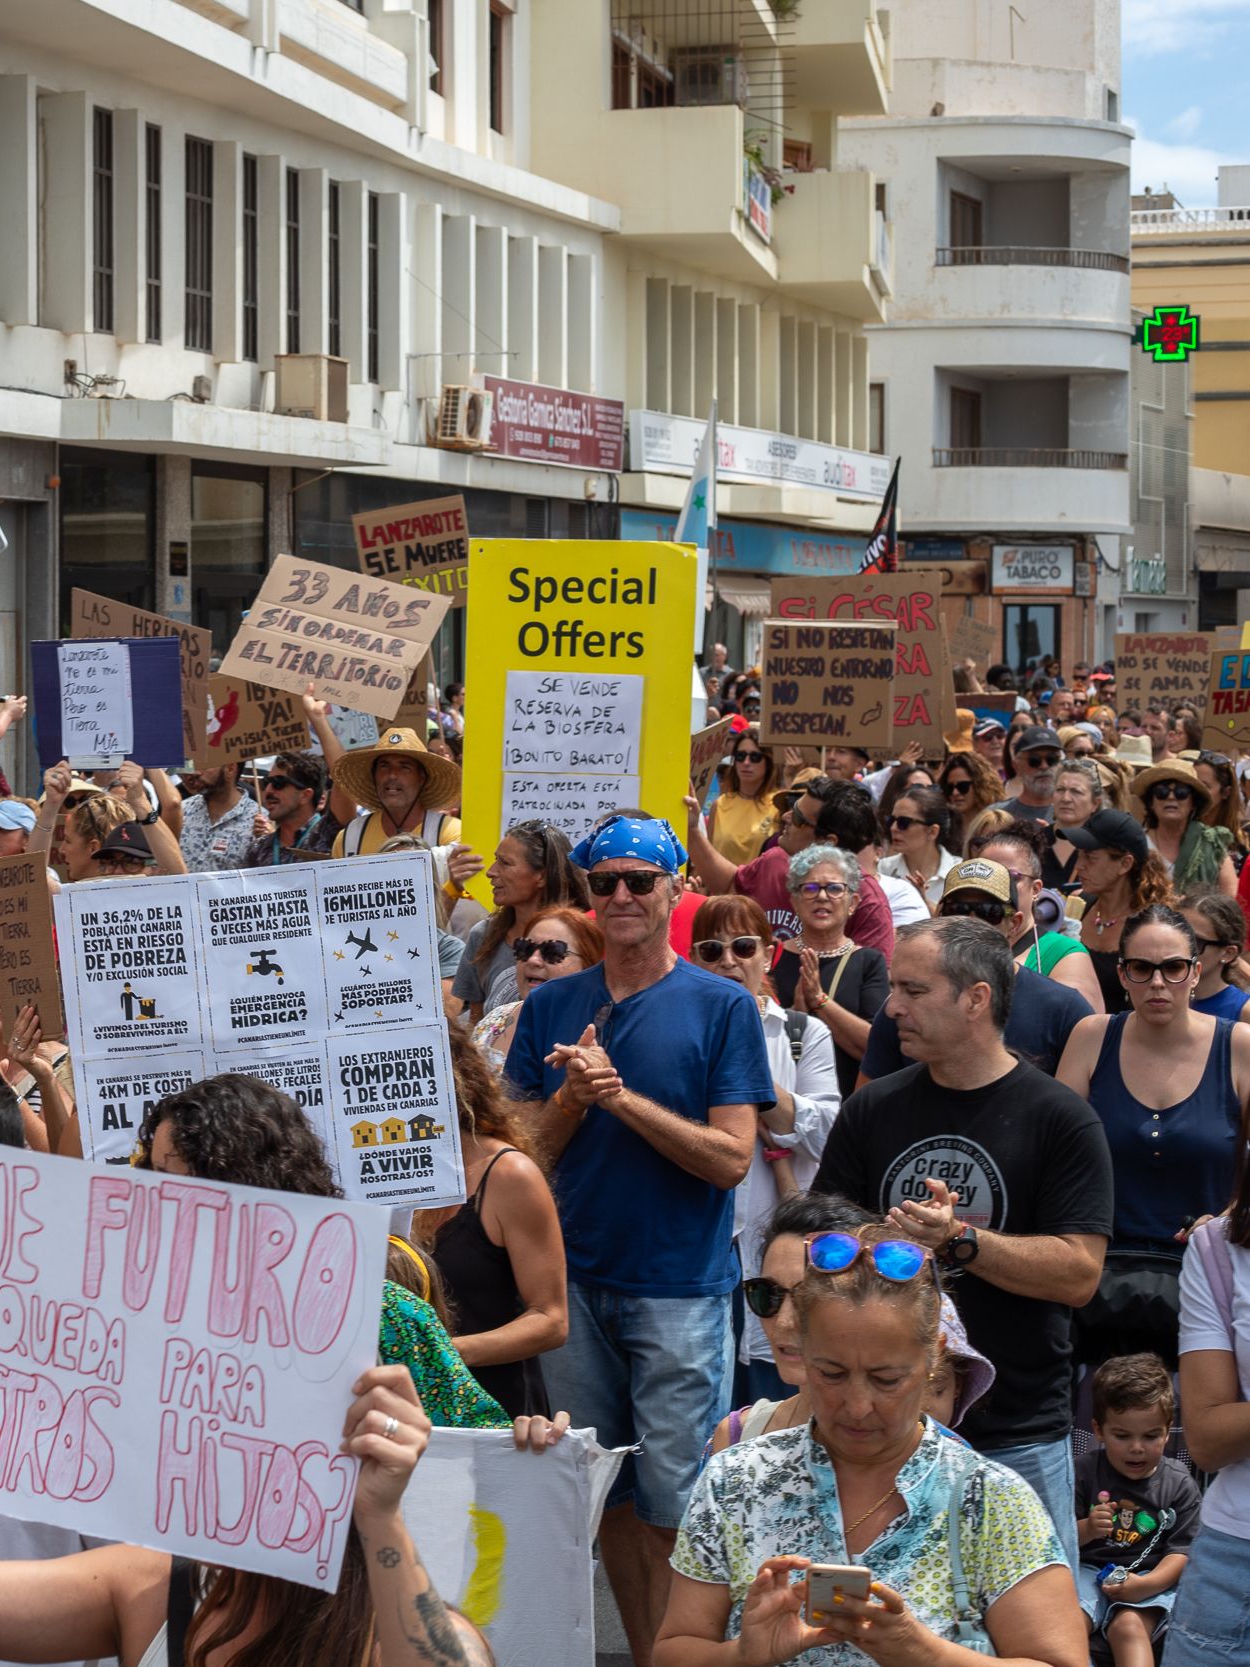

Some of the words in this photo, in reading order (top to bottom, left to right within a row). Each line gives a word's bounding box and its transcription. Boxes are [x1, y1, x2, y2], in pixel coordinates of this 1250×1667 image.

[528, 392, 554, 429] Garnica
[555, 396, 580, 434] Sánchez
[358, 508, 464, 549] LANZAROTE
[365, 548, 400, 577] SE
[405, 538, 468, 571] MUERE
[1005, 565, 1061, 579] TABACO
[281, 569, 330, 604] 33
[333, 584, 430, 629] AÑOS
[508, 567, 657, 612] Special
[81, 599, 110, 625] LAS
[827, 585, 936, 632] CÉSAR
[518, 619, 645, 658] Offers
[796, 628, 824, 650] NO
[829, 628, 894, 651] RESPETAN
[239, 639, 273, 664] EL
[766, 657, 825, 677] NUESTRO
[830, 658, 894, 681] ENTORNO,
[1118, 656, 1138, 669] NO
[1142, 657, 1158, 670] SE
[1166, 657, 1209, 673] VENDE
[537, 677, 564, 693] SE
[571, 680, 621, 696] VENDE
[772, 680, 799, 706] NO
[822, 685, 854, 706] NOS
[1124, 677, 1140, 690] SE
[1150, 677, 1193, 690] AMA
[1198, 678, 1209, 690] Y
[258, 698, 293, 727] YA!
[514, 699, 581, 717] RESERVA
[592, 706, 616, 718] DE
[512, 720, 535, 732] LA
[545, 720, 625, 735] BIOSFERA
[769, 712, 852, 737] RESPETAN.
[240, 746, 258, 758] UN
[570, 746, 631, 773] BARATO!
[512, 781, 539, 792] ESTA
[547, 782, 587, 792] OFERTA
[593, 780, 620, 792] ESTÁ
[511, 800, 585, 811] PATROCINADA
[598, 801, 617, 811] POR
[210, 905, 262, 923] GASTAN
[267, 899, 309, 917] HASTA
[0, 922, 31, 940] TIERRA
[20, 950, 31, 966] ES
[85, 954, 106, 970] DE
[111, 947, 186, 968] POBREZA
[8, 977, 43, 996] TIERRA
[230, 998, 306, 1015] EMERGENCIA
[341, 993, 413, 1010] SOPORTAR?
[231, 1009, 308, 1029] HÍDRICA?
[340, 1058, 435, 1087] COMPRAN
[295, 1086, 324, 1107] DÍA
[343, 1089, 351, 1105] 1
[358, 1086, 378, 1103] DE
[383, 1081, 423, 1100] CADA
[428, 1079, 437, 1095] 3
[102, 1103, 134, 1131] AL
[360, 1169, 434, 1184] NOSOTRAS/OS?
[361, 1161, 375, 1175] A
[378, 1154, 434, 1173] VIVIR
[915, 1158, 975, 1184] crazy
[82, 1175, 357, 1355] FUTURO
[160, 1337, 265, 1428] PARA
